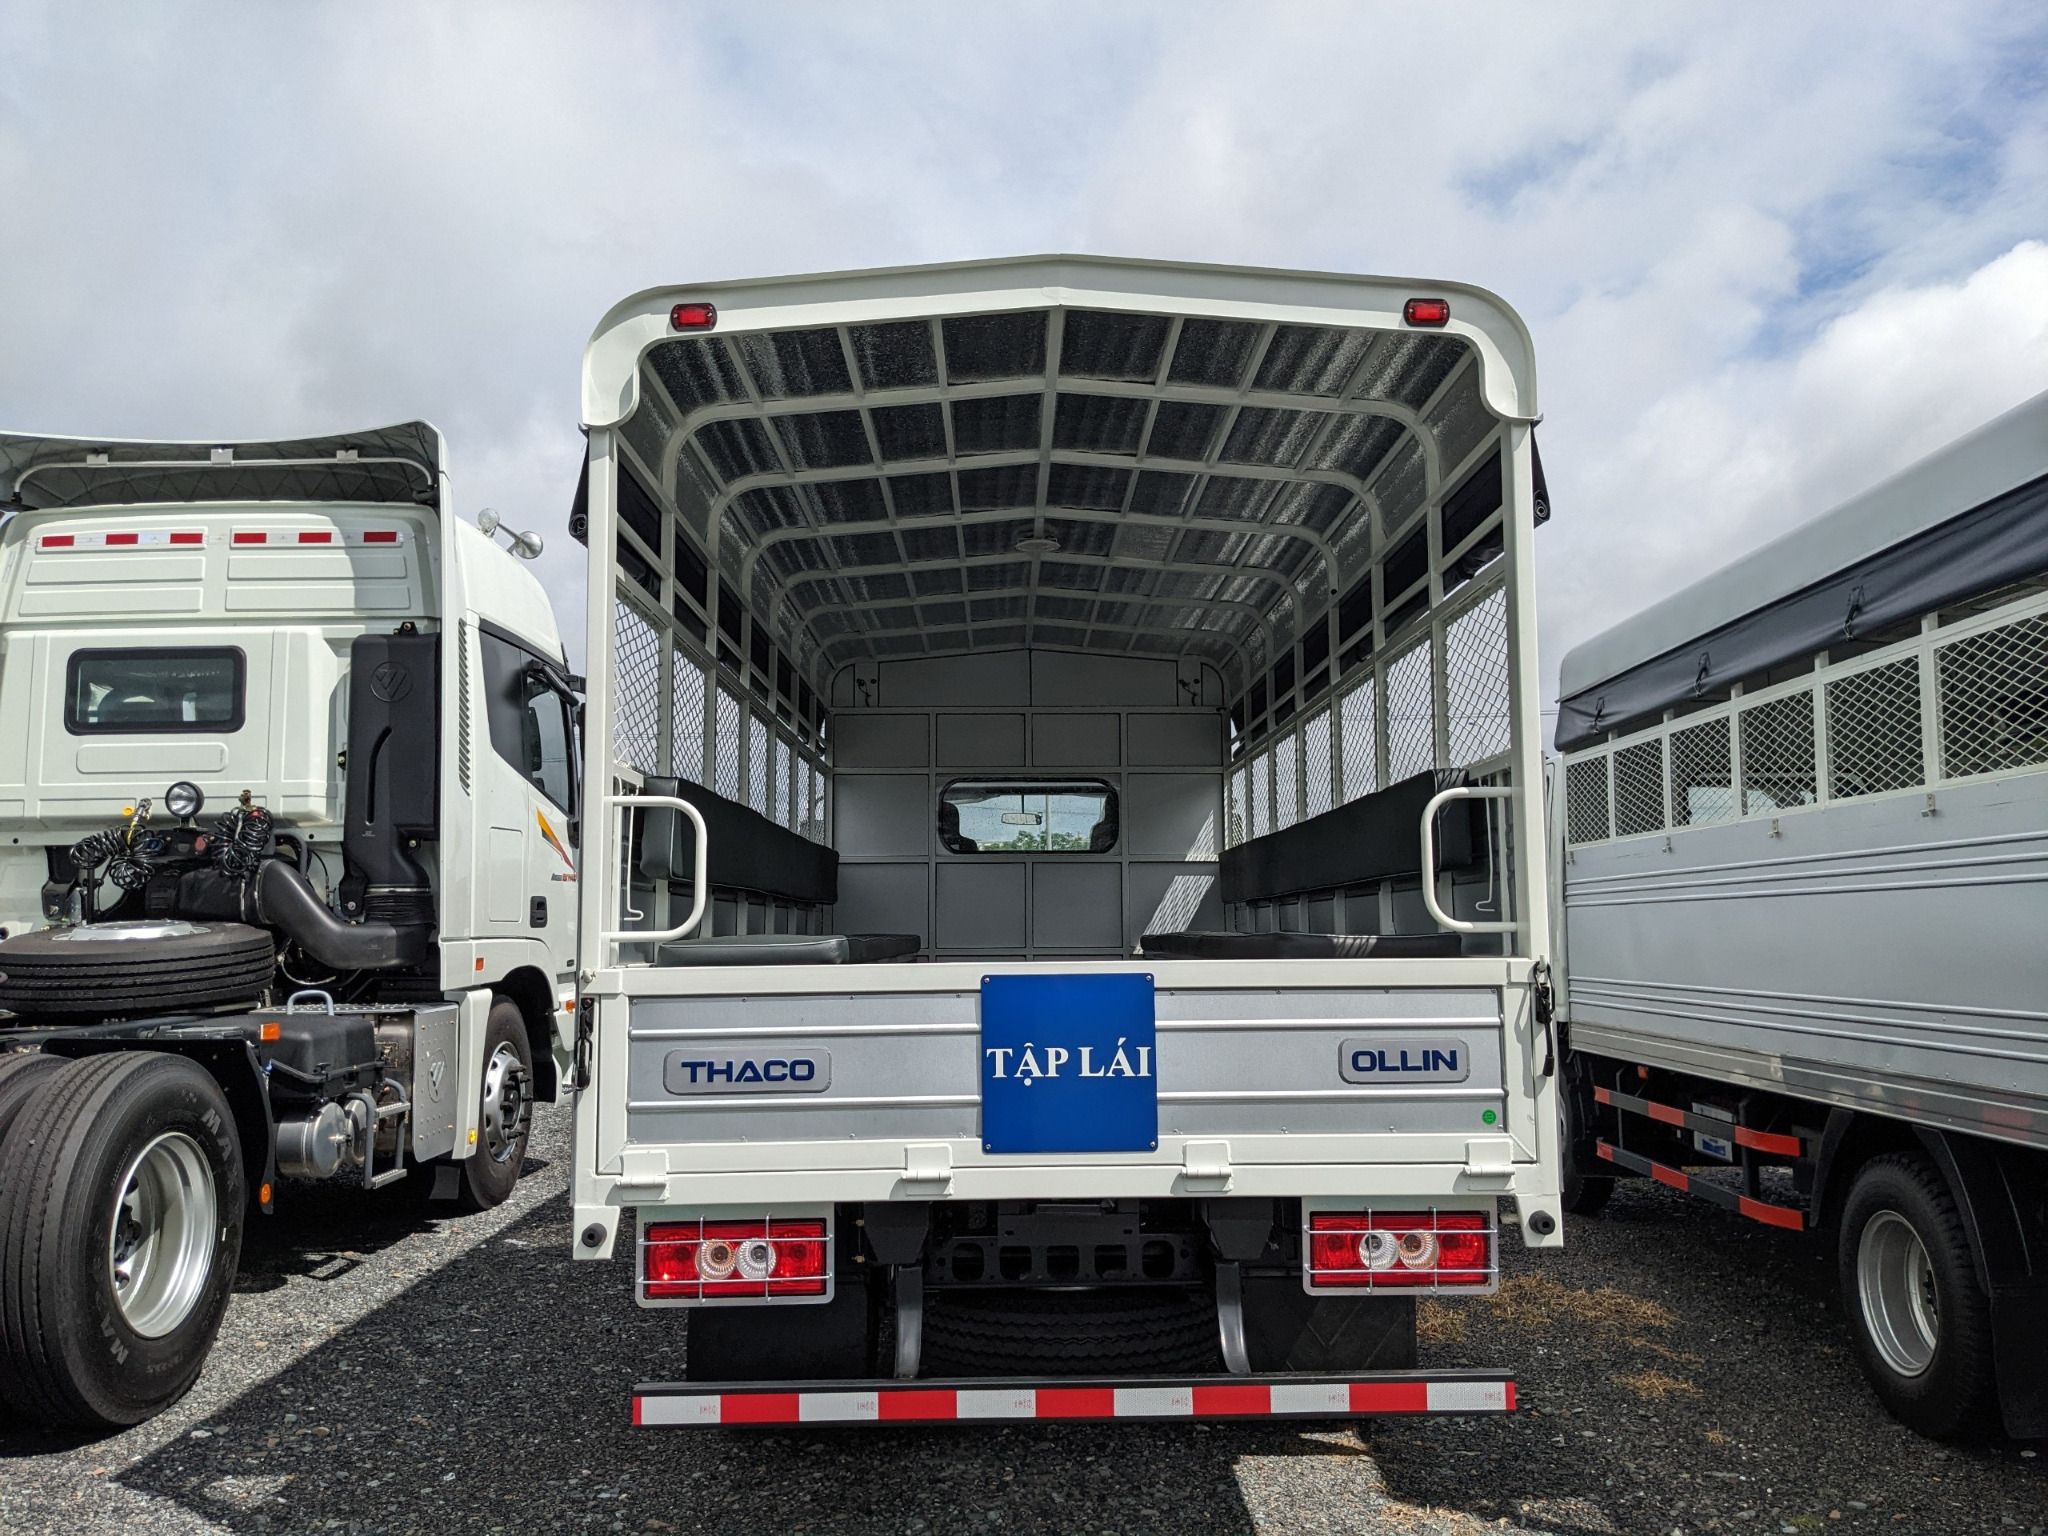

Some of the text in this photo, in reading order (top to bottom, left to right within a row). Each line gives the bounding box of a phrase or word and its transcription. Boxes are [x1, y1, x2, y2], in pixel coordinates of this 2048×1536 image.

[681, 1059, 815, 1083] THACO
[986, 1037, 1152, 1087] TẬP LÁI
[1352, 1050, 1458, 1072] OLLIN
